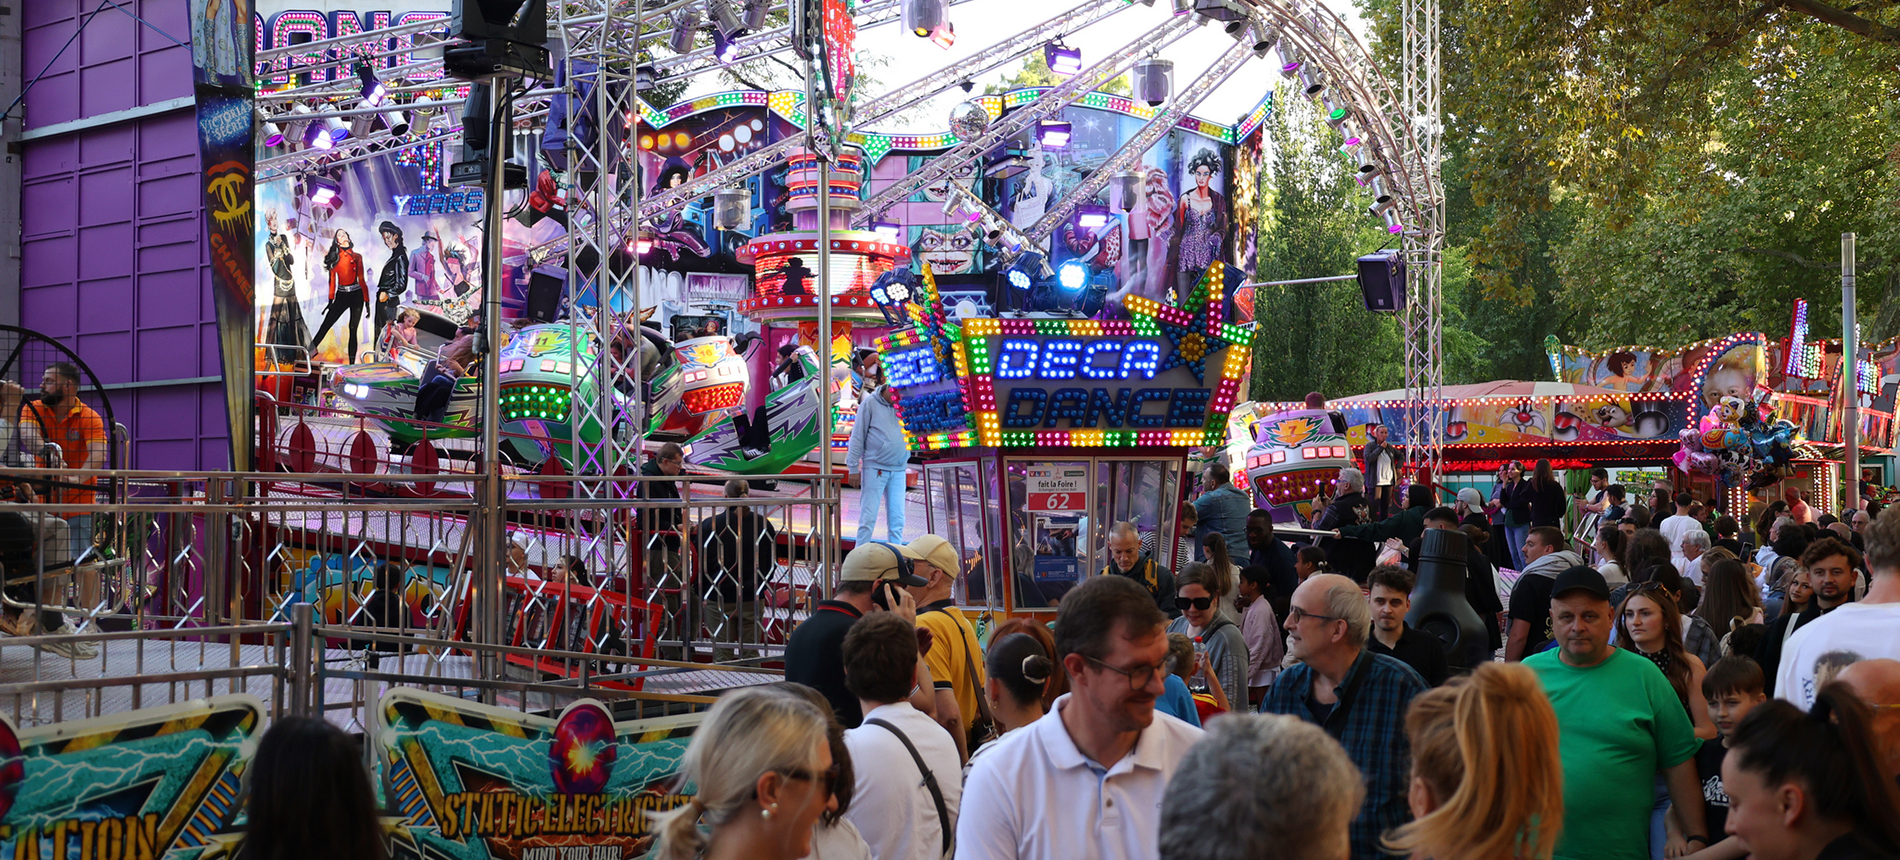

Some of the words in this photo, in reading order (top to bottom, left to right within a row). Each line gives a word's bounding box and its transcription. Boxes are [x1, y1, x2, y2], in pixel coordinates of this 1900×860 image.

[199, 98, 254, 131] VICTORIA'S
[212, 116, 249, 141] SECRET
[392, 191, 483, 217] YEARS
[210, 232, 255, 304] CHANEL
[994, 338, 1161, 381] DECA
[1001, 387, 1211, 429] DANCE
[1288, 425, 1298, 435] 7
[1038, 480, 1050, 488] fait
[1050, 480, 1057, 488] la
[1057, 480, 1074, 488] Foire
[1046, 493, 1070, 510] 62
[441, 791, 539, 838] STATIC
[523, 847, 558, 860] MIND
[559, 846, 591, 860] YOUR
[592, 845, 623, 860] HAIR!
